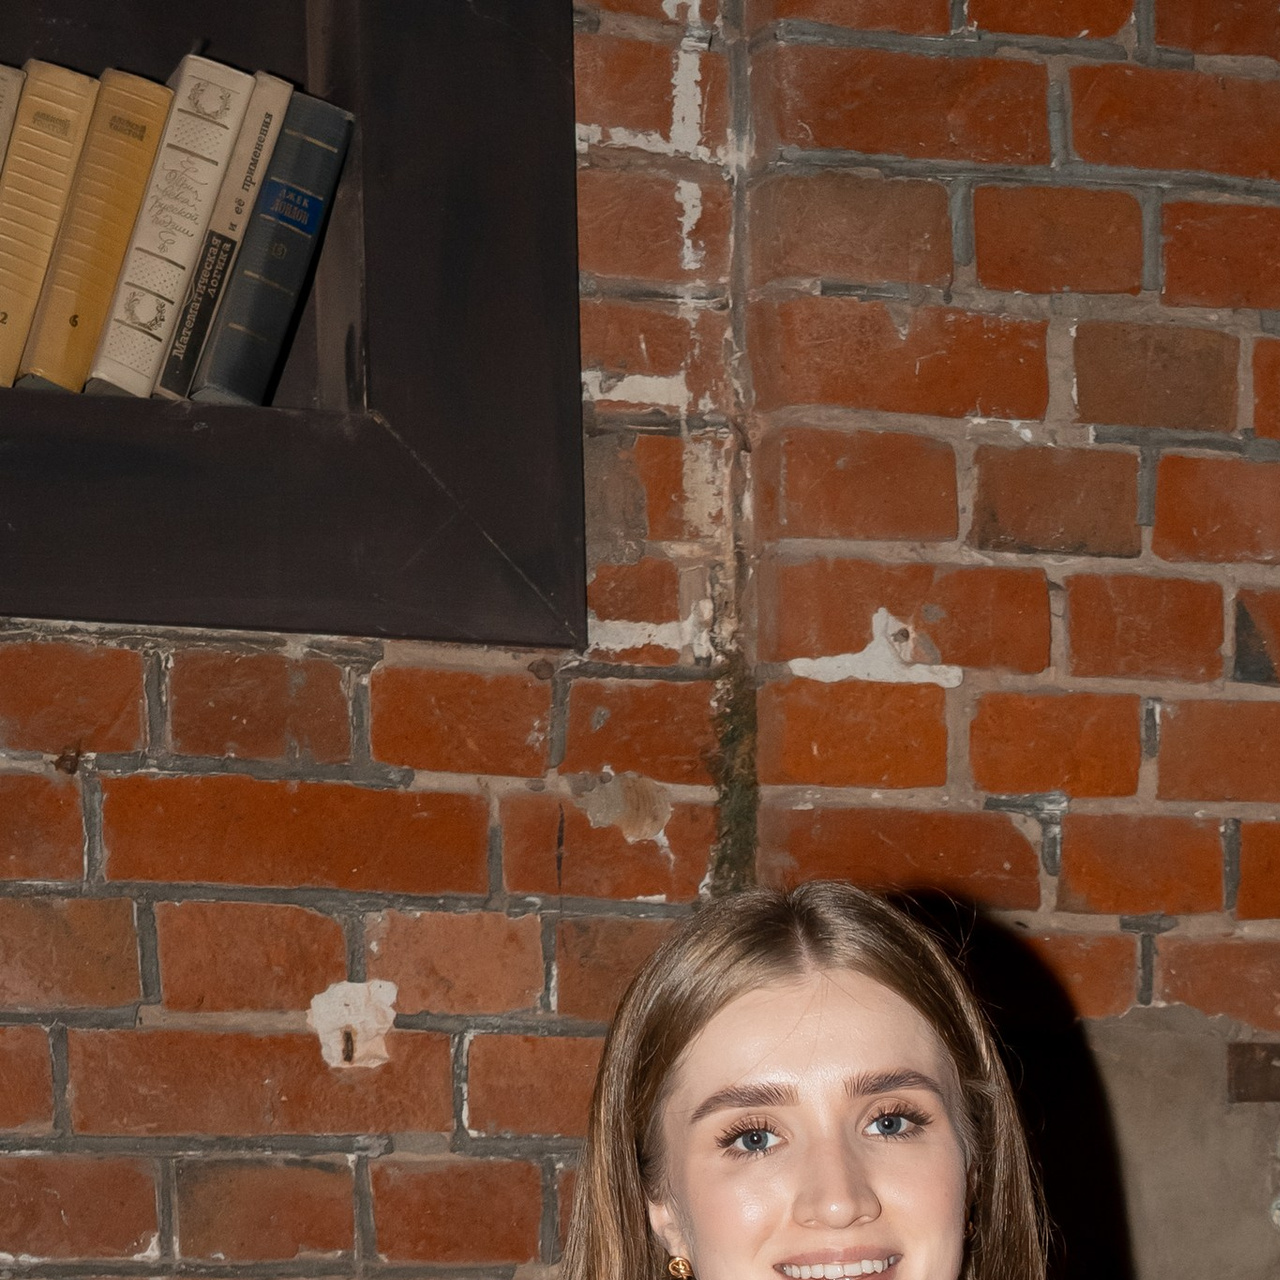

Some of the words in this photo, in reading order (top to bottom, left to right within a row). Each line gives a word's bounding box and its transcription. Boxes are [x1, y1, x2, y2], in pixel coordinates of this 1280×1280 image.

[229, 222, 238, 232] и
[241, 111, 273, 192] применения
[68, 314, 79, 328] 6
[172, 236, 222, 360] Математическая
